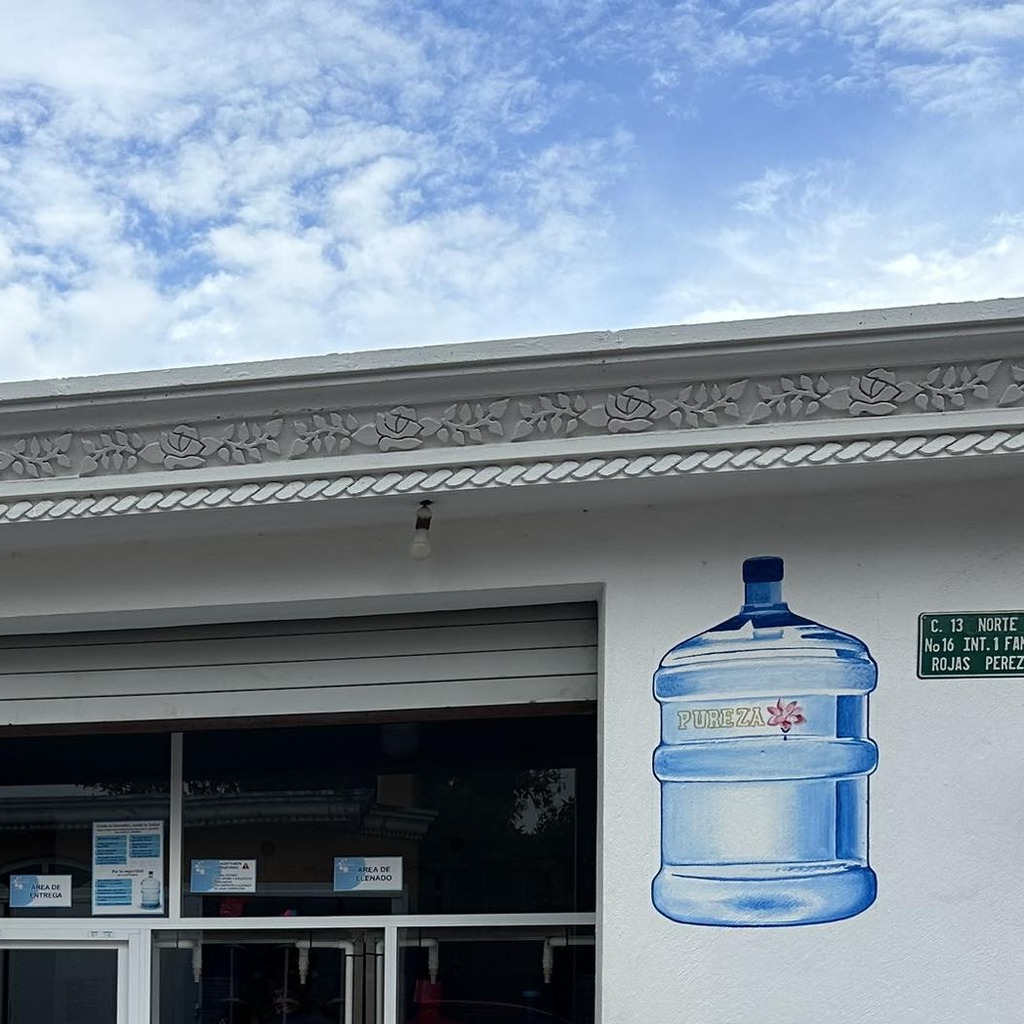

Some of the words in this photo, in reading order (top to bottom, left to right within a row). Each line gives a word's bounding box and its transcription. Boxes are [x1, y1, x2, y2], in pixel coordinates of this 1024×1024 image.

[931, 619, 943, 633] C.
[950, 618, 964, 633] 13
[978, 616, 1018, 632] NORTE
[931, 656, 971, 671] ROJAS
[985, 655, 1024, 671] PEREZ
[677, 706, 765, 730] PUREZA
[356, 874, 393, 882] LLENADO
